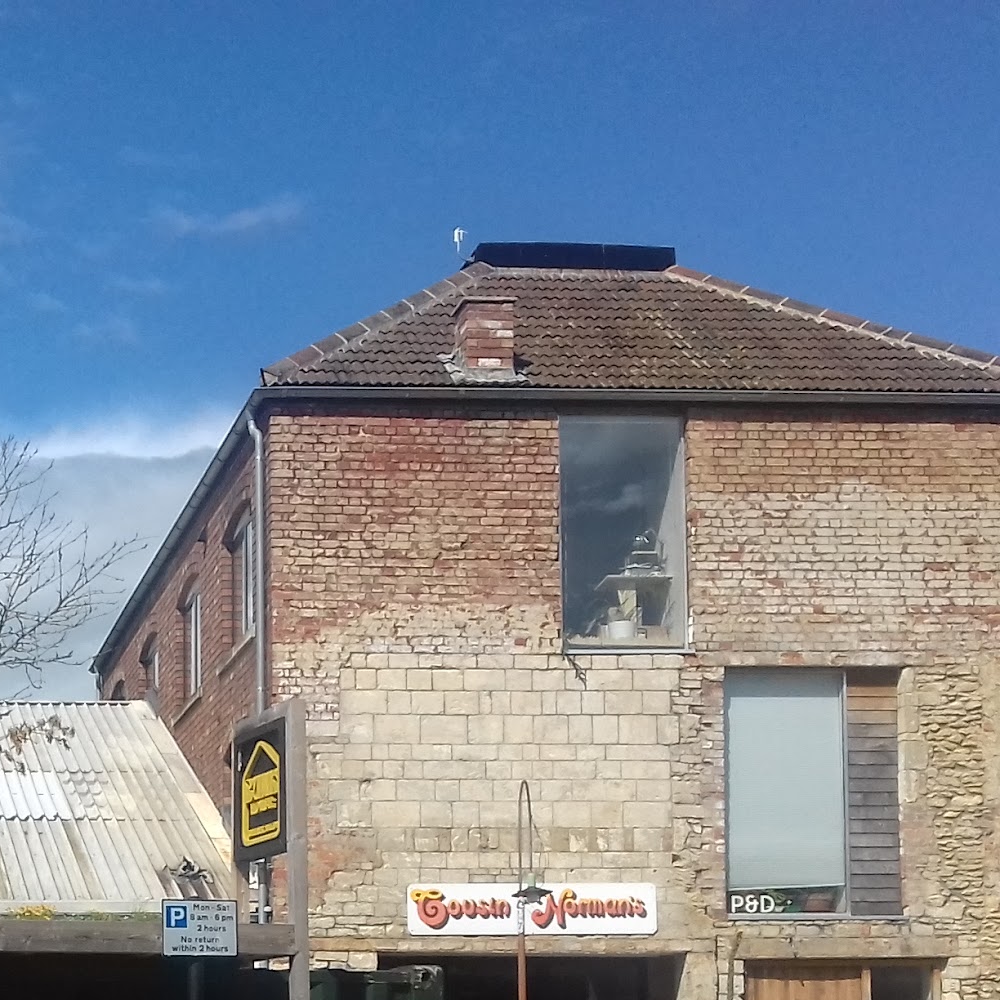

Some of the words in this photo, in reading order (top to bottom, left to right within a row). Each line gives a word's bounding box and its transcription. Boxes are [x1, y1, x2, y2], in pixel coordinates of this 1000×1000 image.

[410, 888, 511, 929] Cousin
[531, 888, 648, 929] Norman's
[730, 894, 776, 913] P&D
[170, 907, 185, 927] P
[203, 924, 227, 932] hours
